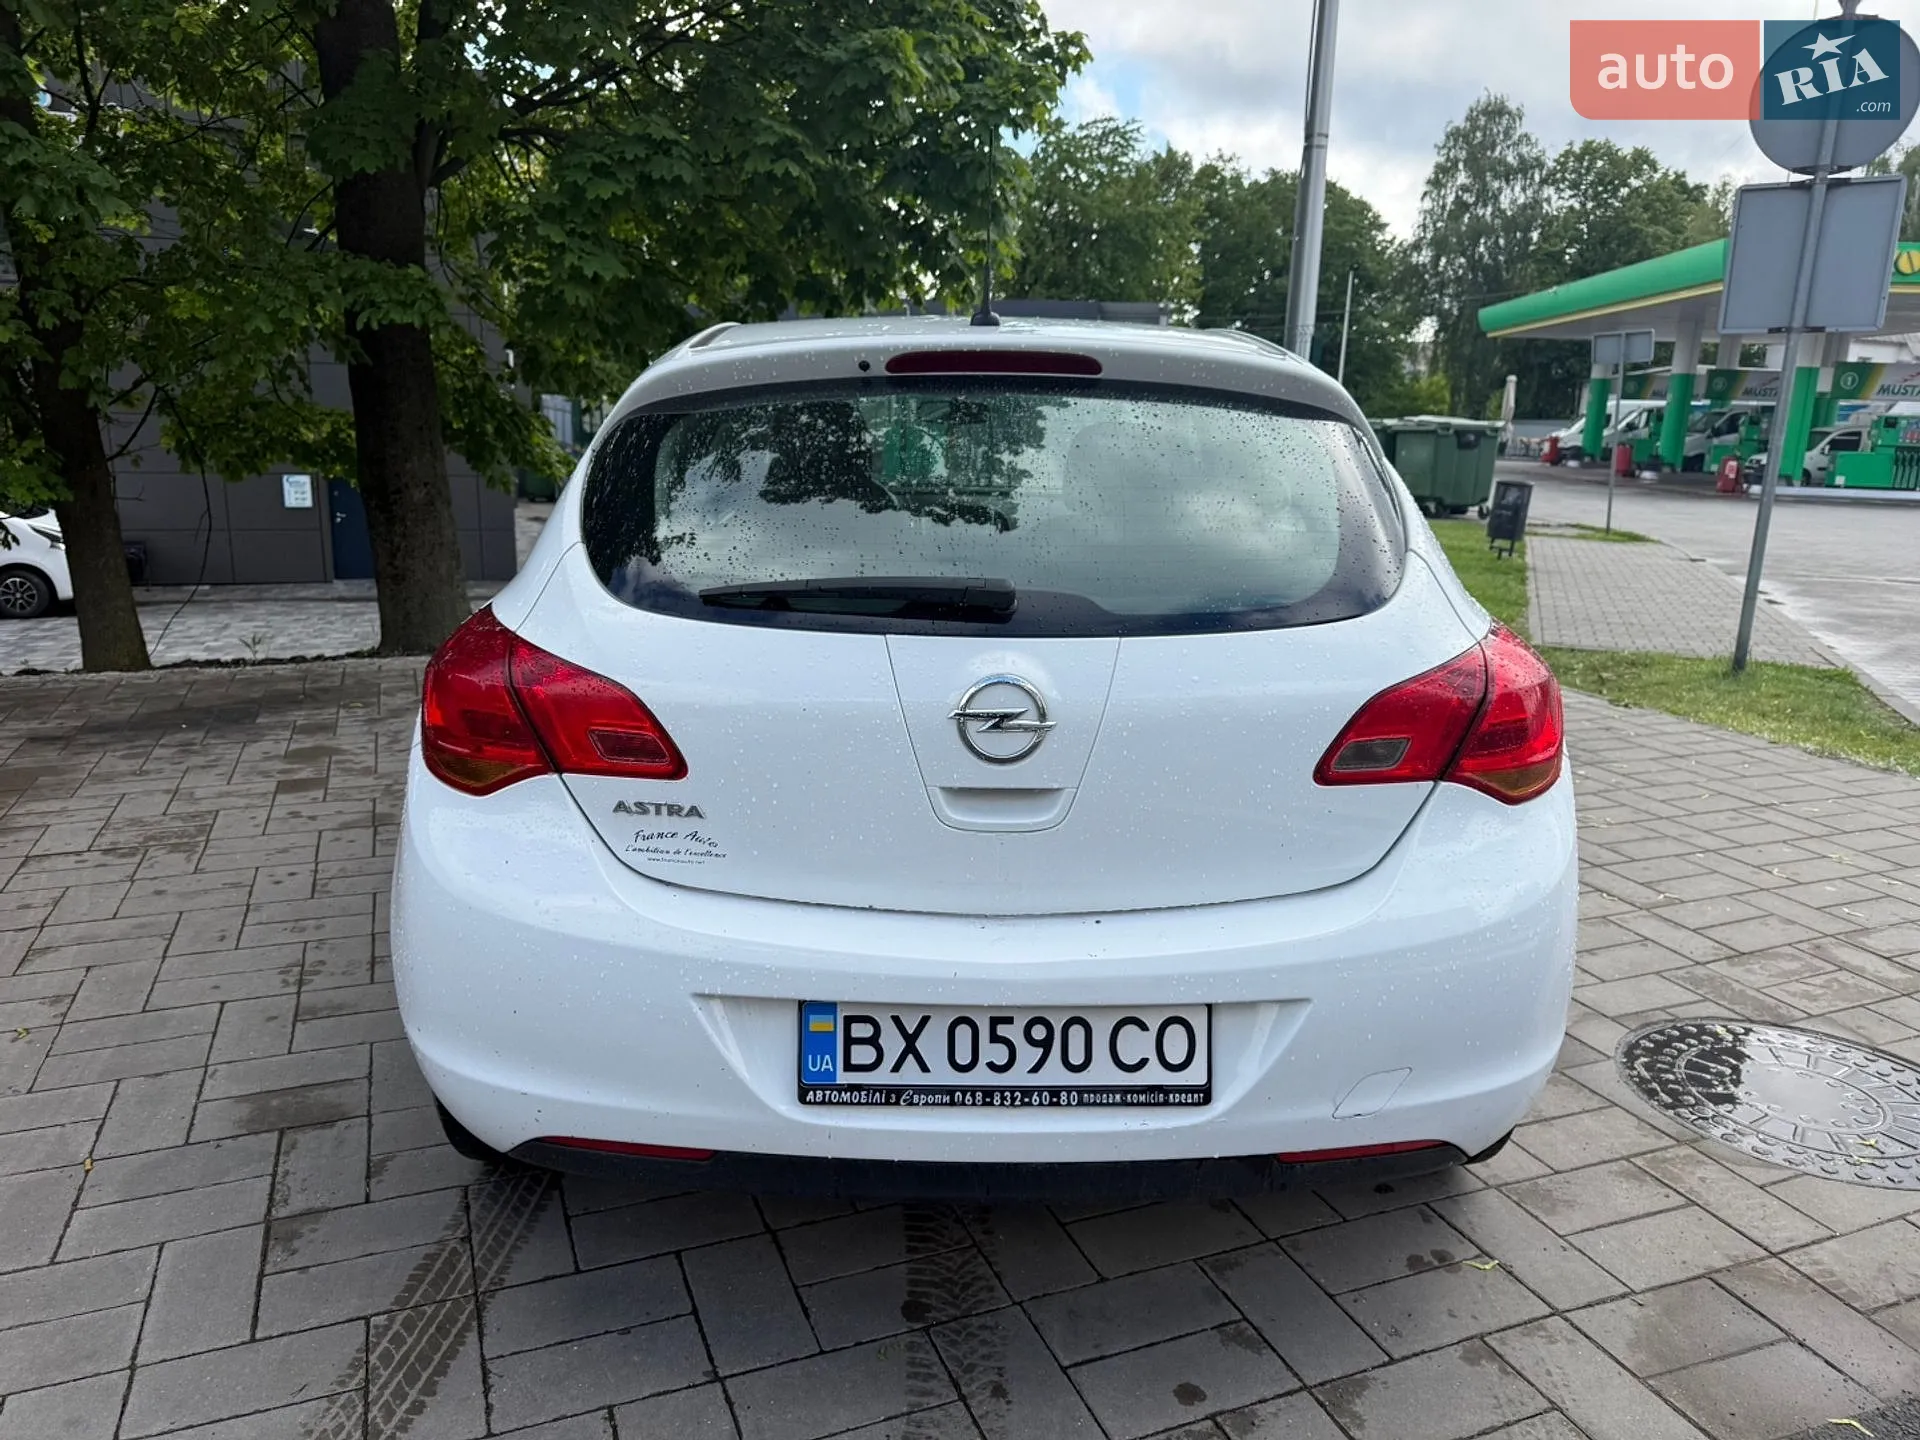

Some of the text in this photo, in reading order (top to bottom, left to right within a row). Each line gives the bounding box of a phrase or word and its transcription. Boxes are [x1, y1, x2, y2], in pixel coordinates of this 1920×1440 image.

[612, 799, 705, 819] ASTRA
[634, 829, 679, 843] France
[842, 1014, 1197, 1073] BX 0590 CO
[808, 1054, 833, 1072] UA
[954, 1091, 1079, 1106] 068-832-60-80
